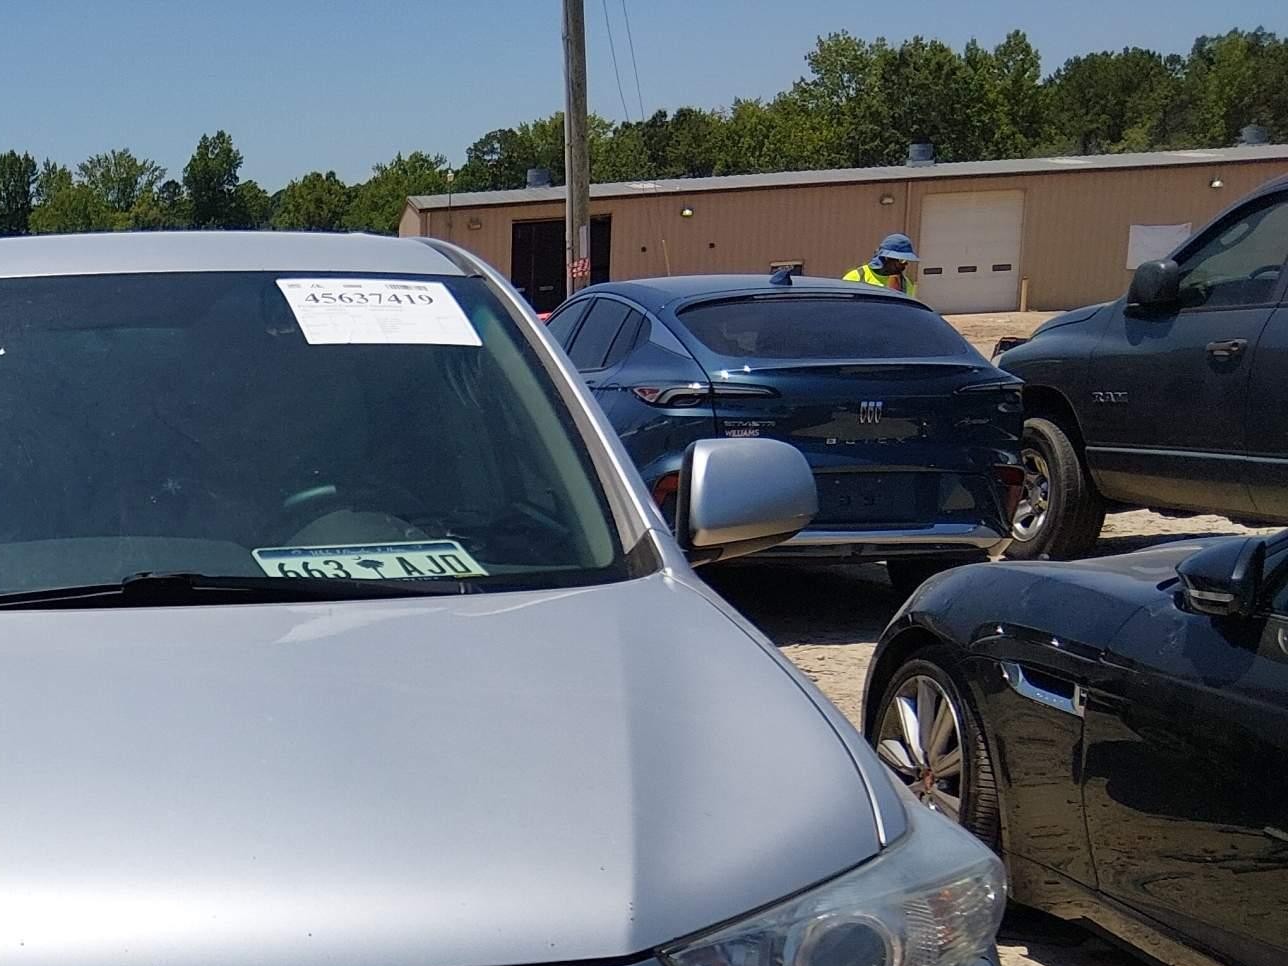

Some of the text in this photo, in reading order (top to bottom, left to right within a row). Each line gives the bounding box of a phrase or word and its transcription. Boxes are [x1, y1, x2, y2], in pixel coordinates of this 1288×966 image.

[304, 292, 434, 306] 45637419
[725, 429, 760, 438] WILLIAMS
[277, 559, 353, 579] 663
